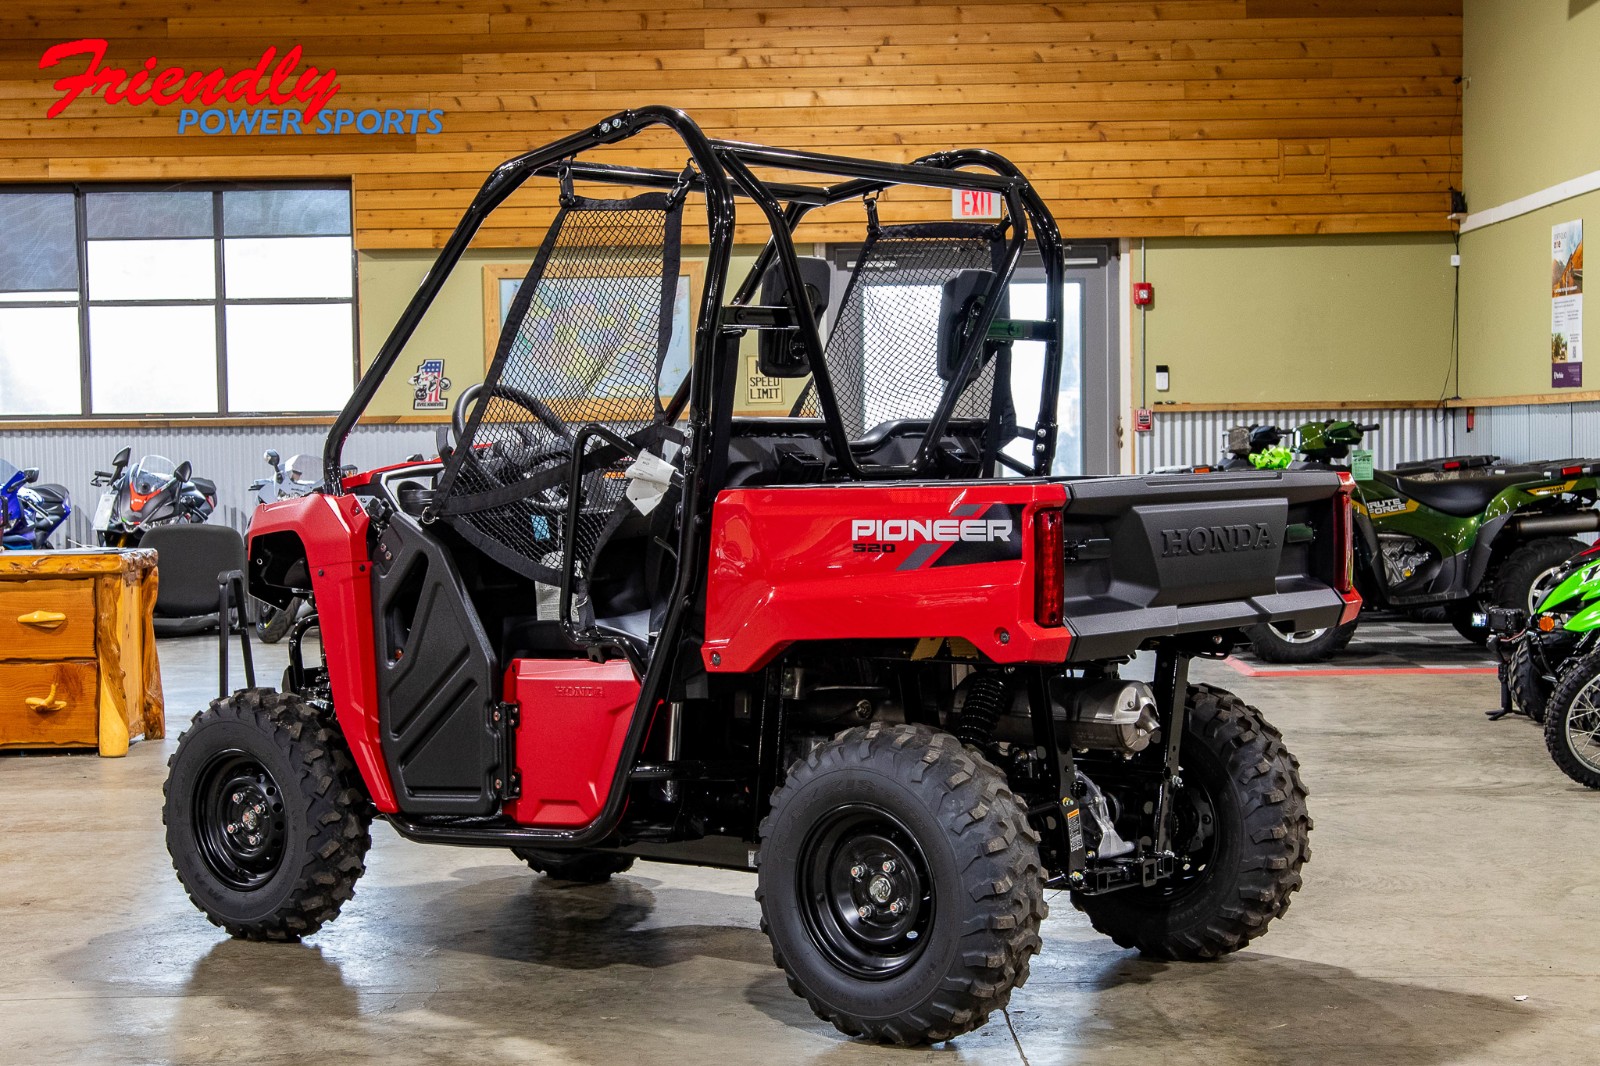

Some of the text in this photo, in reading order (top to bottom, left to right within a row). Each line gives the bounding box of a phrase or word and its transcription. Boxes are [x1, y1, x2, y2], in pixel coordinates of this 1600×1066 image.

[961, 190, 993, 216] EXIT
[749, 376, 780, 387] SPEED
[750, 388, 780, 400] LIMIT
[852, 519, 1013, 542] PIONEER
[1161, 522, 1278, 558] HONDA
[852, 543, 896, 553] 520
[554, 686, 604, 697] HONDA
